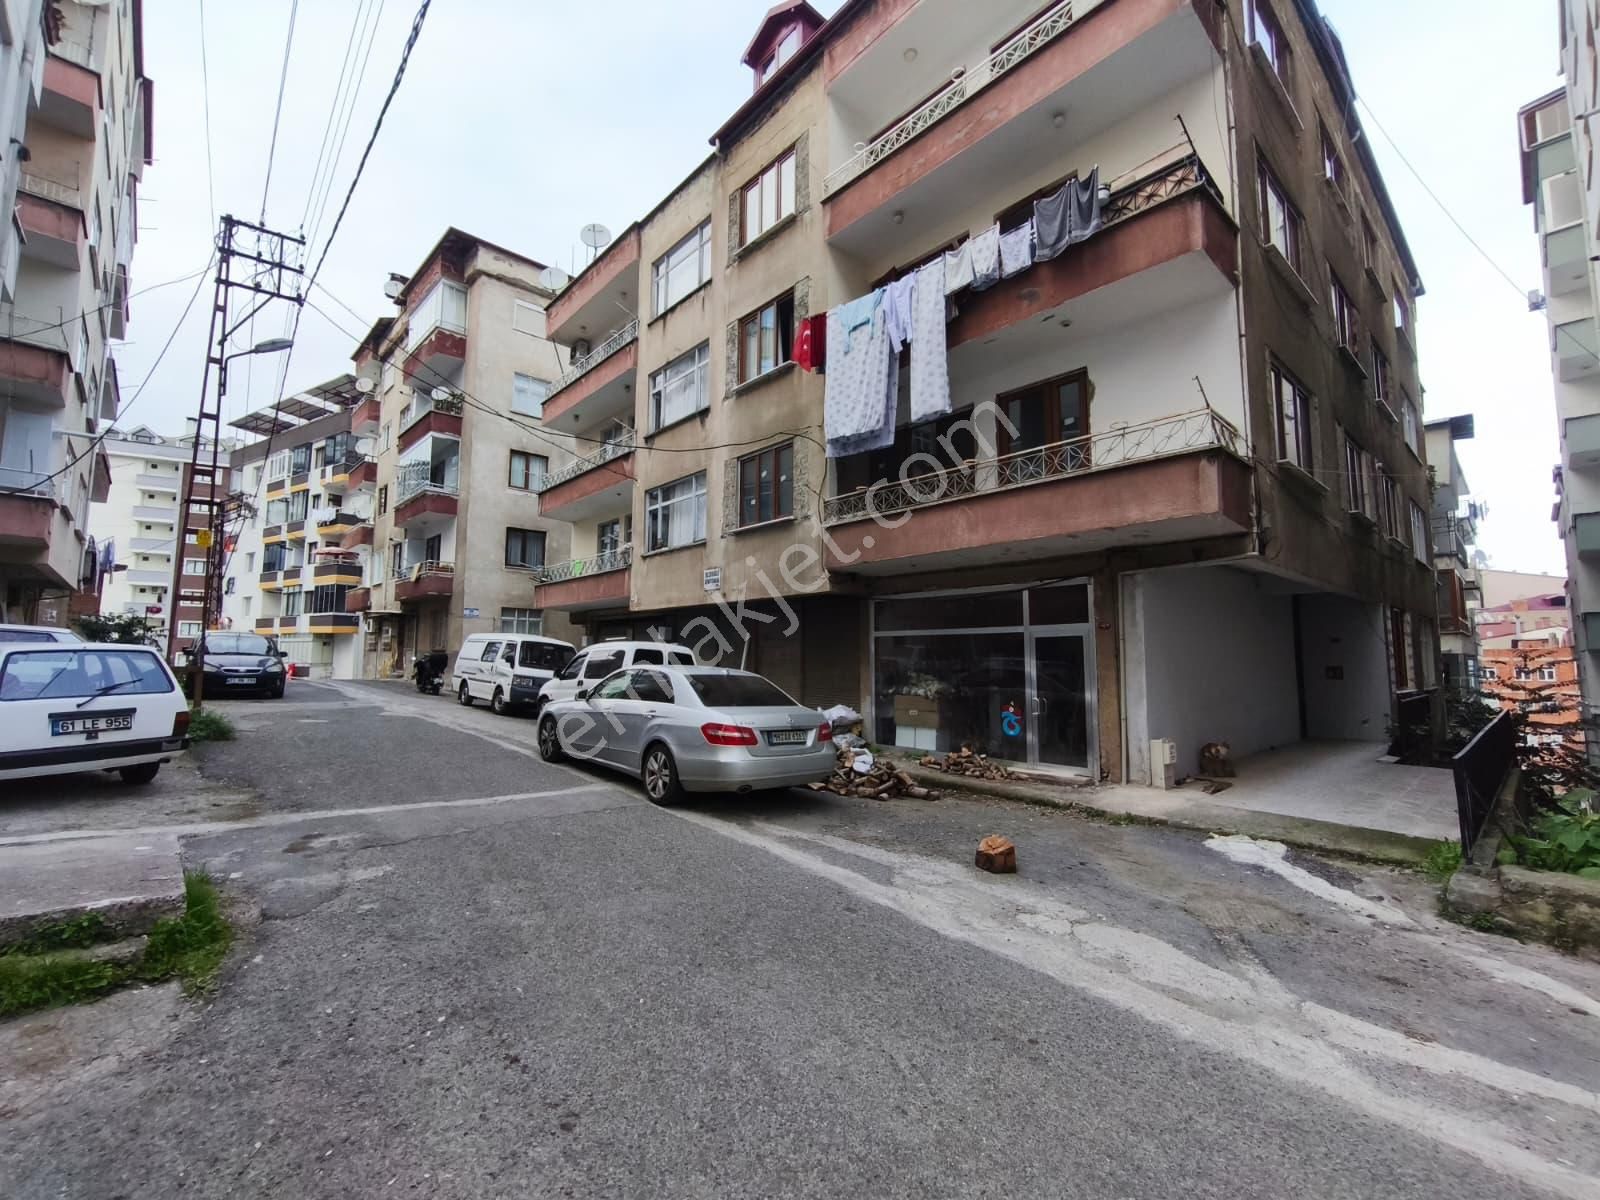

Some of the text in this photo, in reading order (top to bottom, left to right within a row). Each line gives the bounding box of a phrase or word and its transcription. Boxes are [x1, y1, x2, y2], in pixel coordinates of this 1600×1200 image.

[60, 717, 130, 732] 61 LE 955
